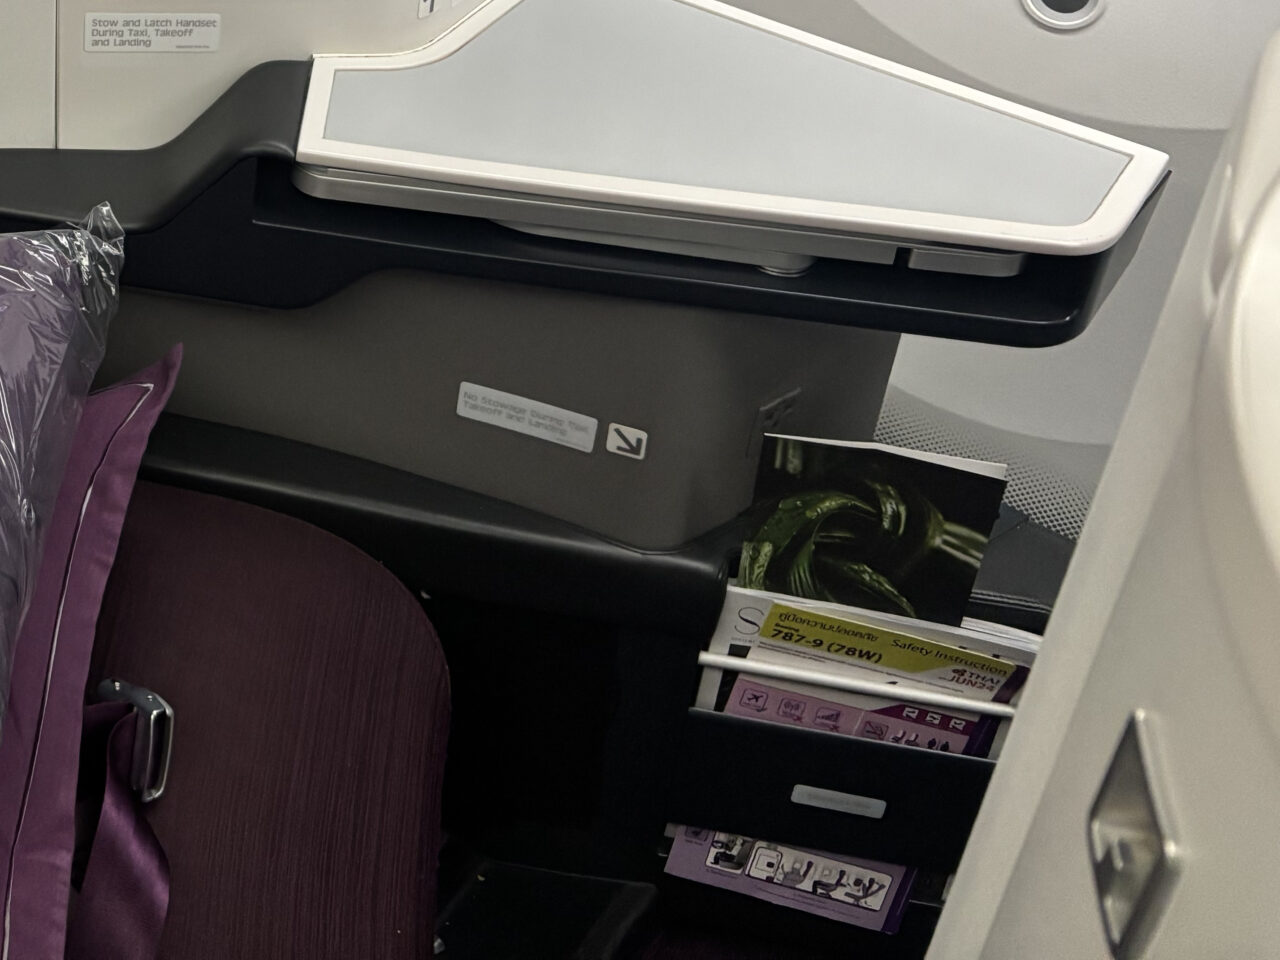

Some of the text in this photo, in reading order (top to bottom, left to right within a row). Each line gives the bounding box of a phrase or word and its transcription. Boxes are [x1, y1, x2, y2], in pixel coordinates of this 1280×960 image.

[91, 18, 218, 28] Stow and Latch Handset
[91, 28, 194, 38] During Taxi, Takeoff
[91, 38, 152, 48] and Landing
[771, 628, 824, 648] 787-9
[827, 641, 883, 664] (78W)
[891, 638, 1009, 678] Safety Instruction
[948, 674, 996, 692] JUN24
[968, 670, 1001, 685] THAI
